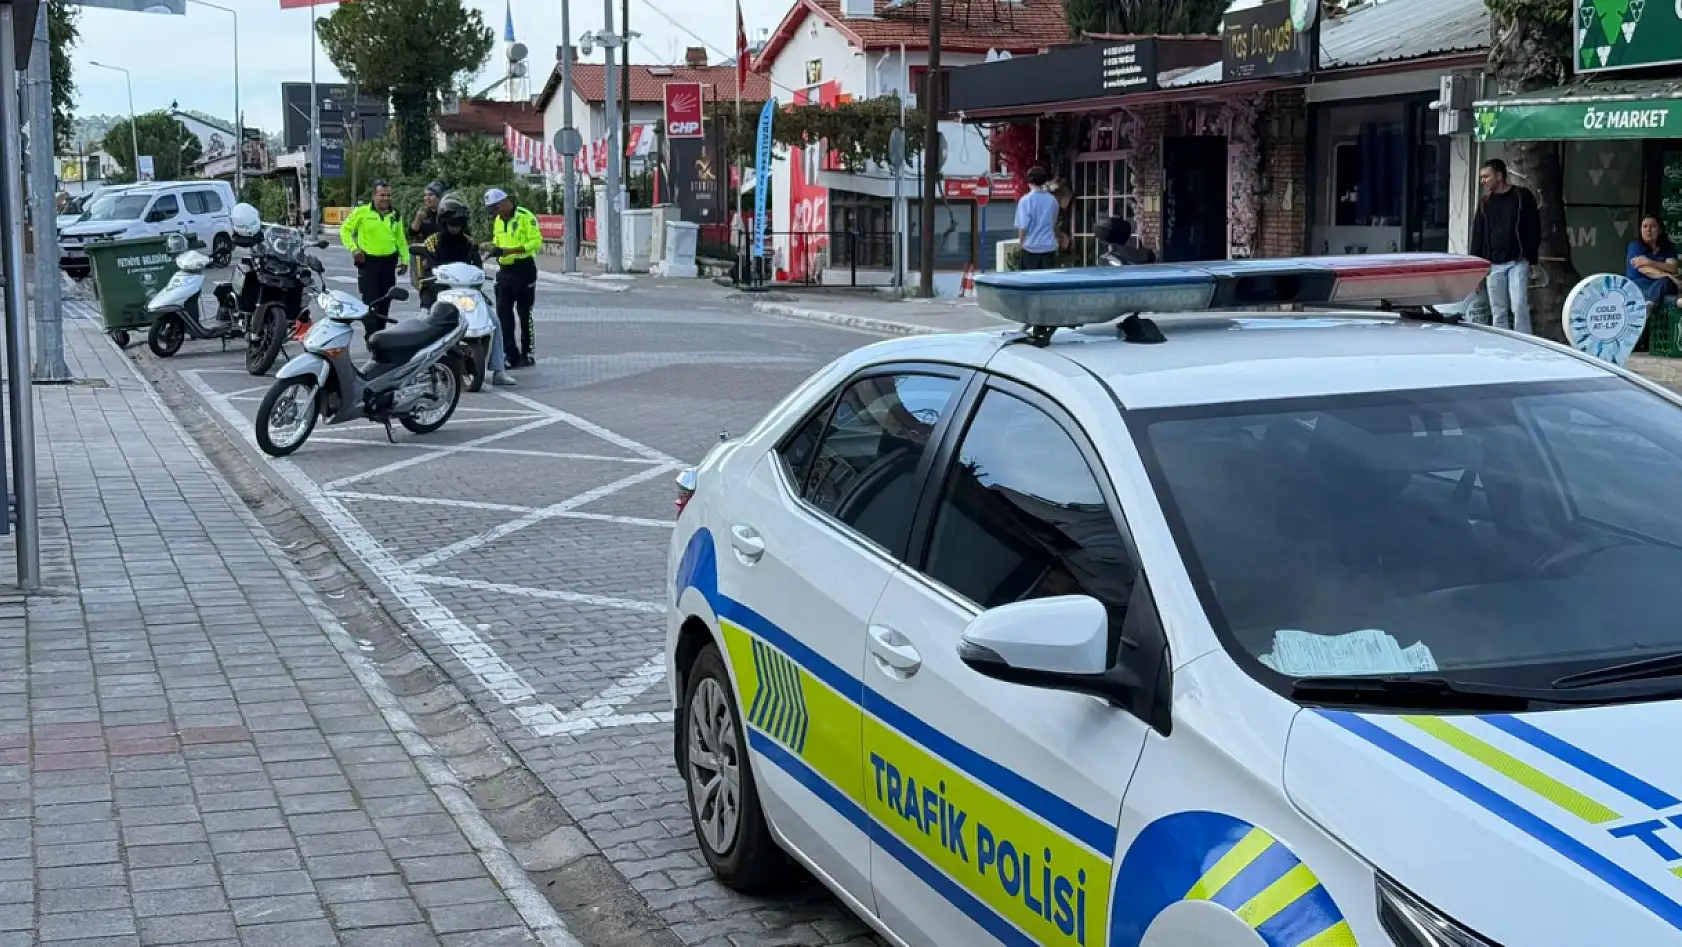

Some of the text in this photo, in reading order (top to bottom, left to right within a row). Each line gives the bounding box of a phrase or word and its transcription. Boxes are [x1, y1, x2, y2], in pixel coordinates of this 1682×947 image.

[1583, 107, 1668, 129] ÖZ MARKET
[669, 122, 699, 134] CHP
[1595, 305, 1617, 313] COLD
[1590, 313, 1622, 321] FILTERED
[869, 752, 1086, 947] TRAFİK POLİSİ
